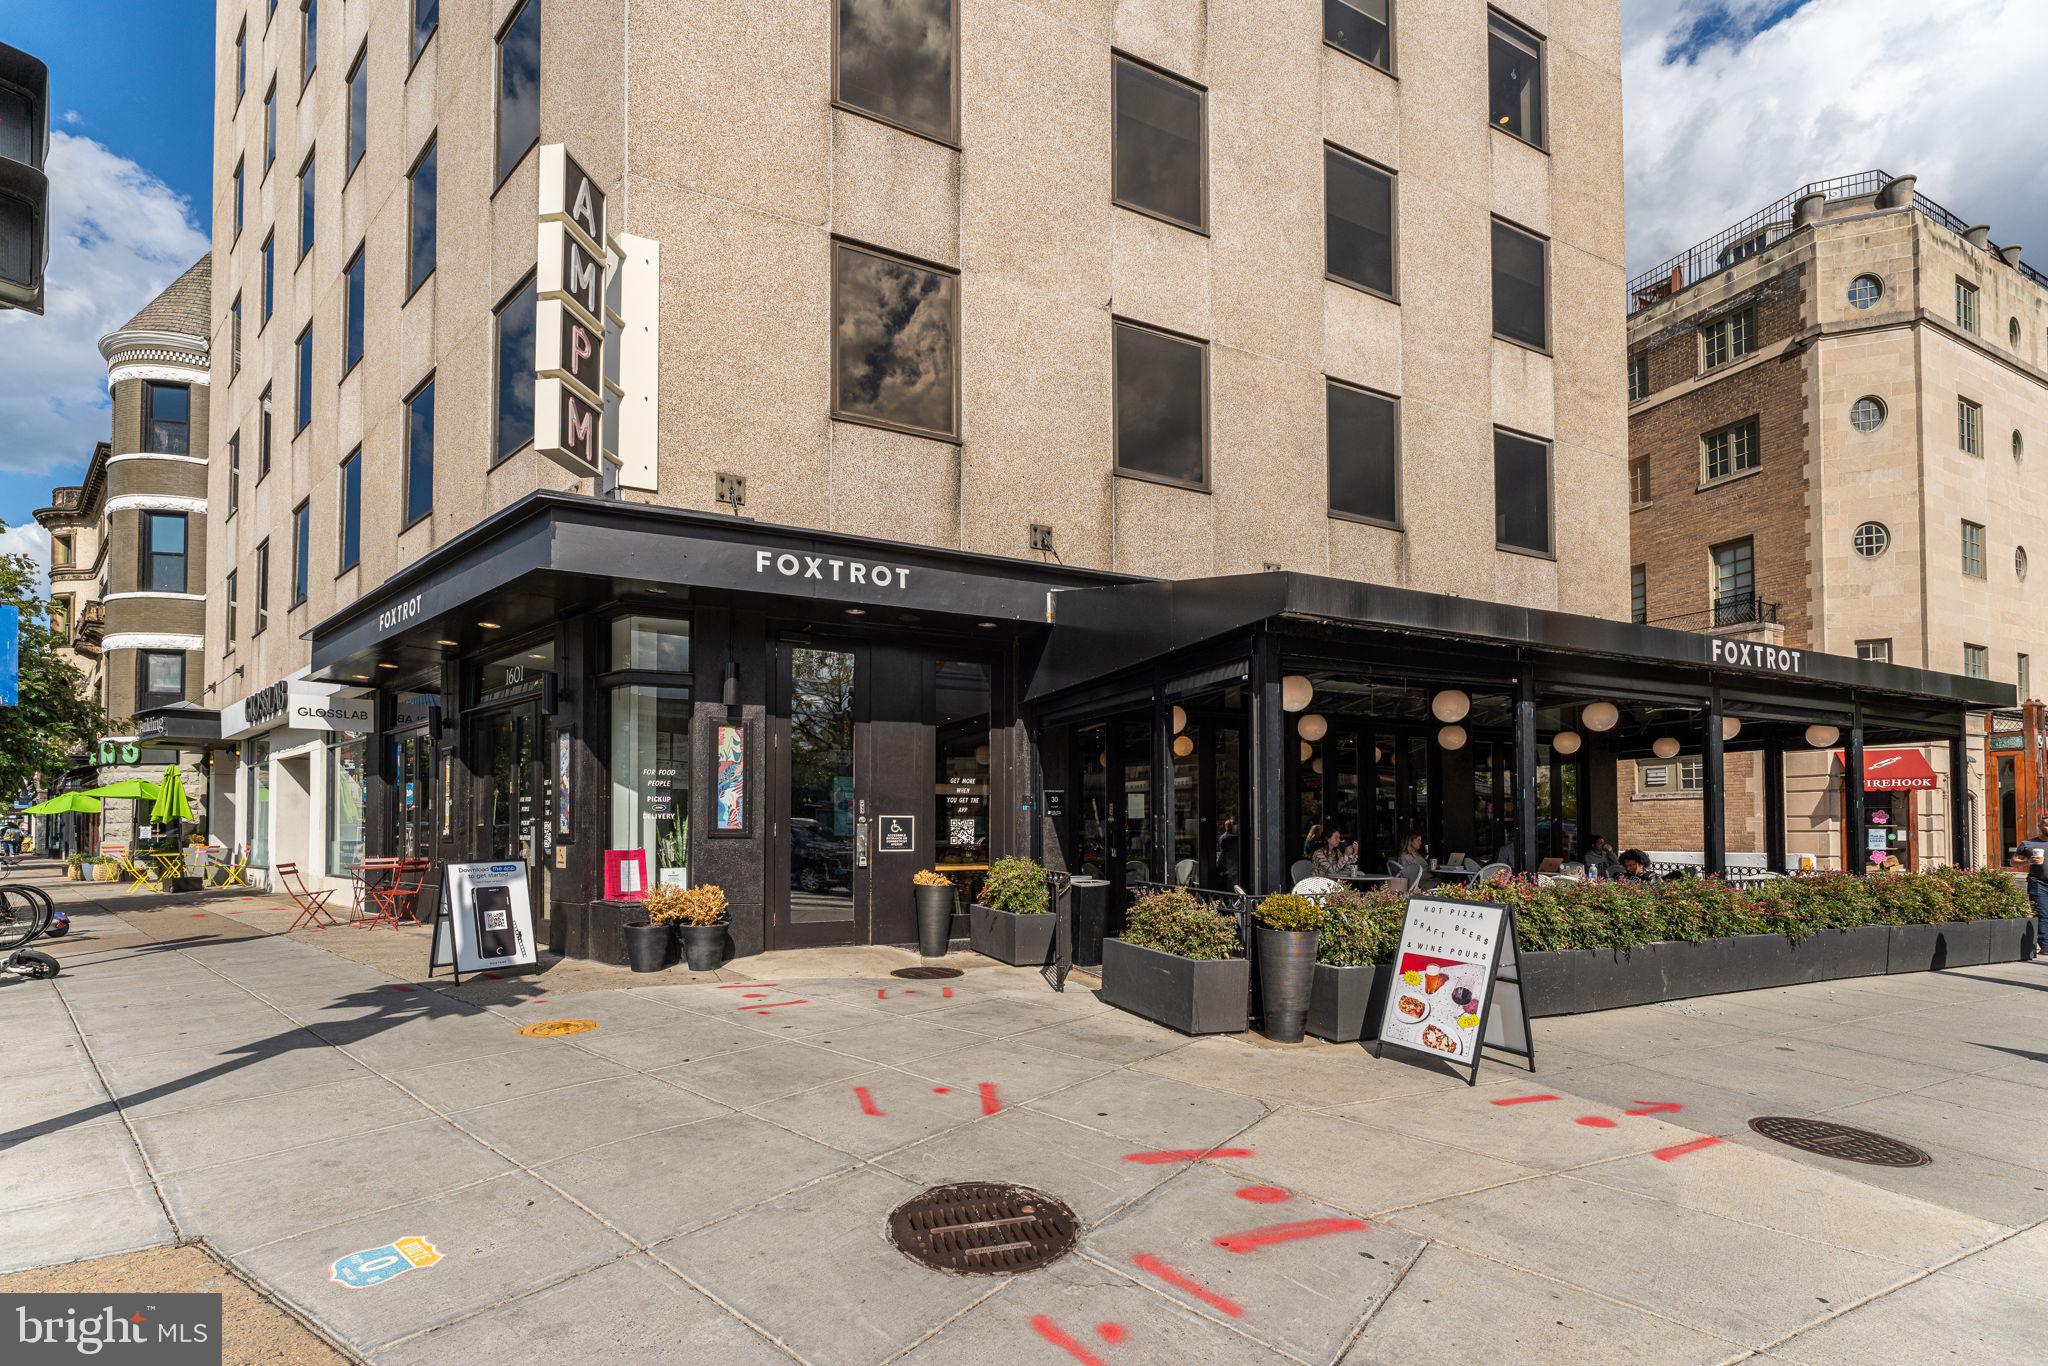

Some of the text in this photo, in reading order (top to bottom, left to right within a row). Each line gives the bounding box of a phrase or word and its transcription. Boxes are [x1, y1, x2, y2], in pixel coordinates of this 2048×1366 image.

[756, 550, 910, 589] FOXTROT
[379, 594, 422, 632] FOXTROT
[1712, 639, 1800, 673] FOXTROT
[505, 665, 524, 686] 1601
[245, 681, 288, 723] GLOSSLAB
[297, 707, 369, 721] GLOSSLAB
[642, 768, 657, 776] FOR
[1863, 778, 1932, 788] IREHOOK
[1423, 905, 1483, 919] HOT PIZZA
[1413, 919, 1489, 945] DRAFT BEERS
[1417, 942, 1443, 953] WINE
[1449, 948, 1487, 960] POURS
